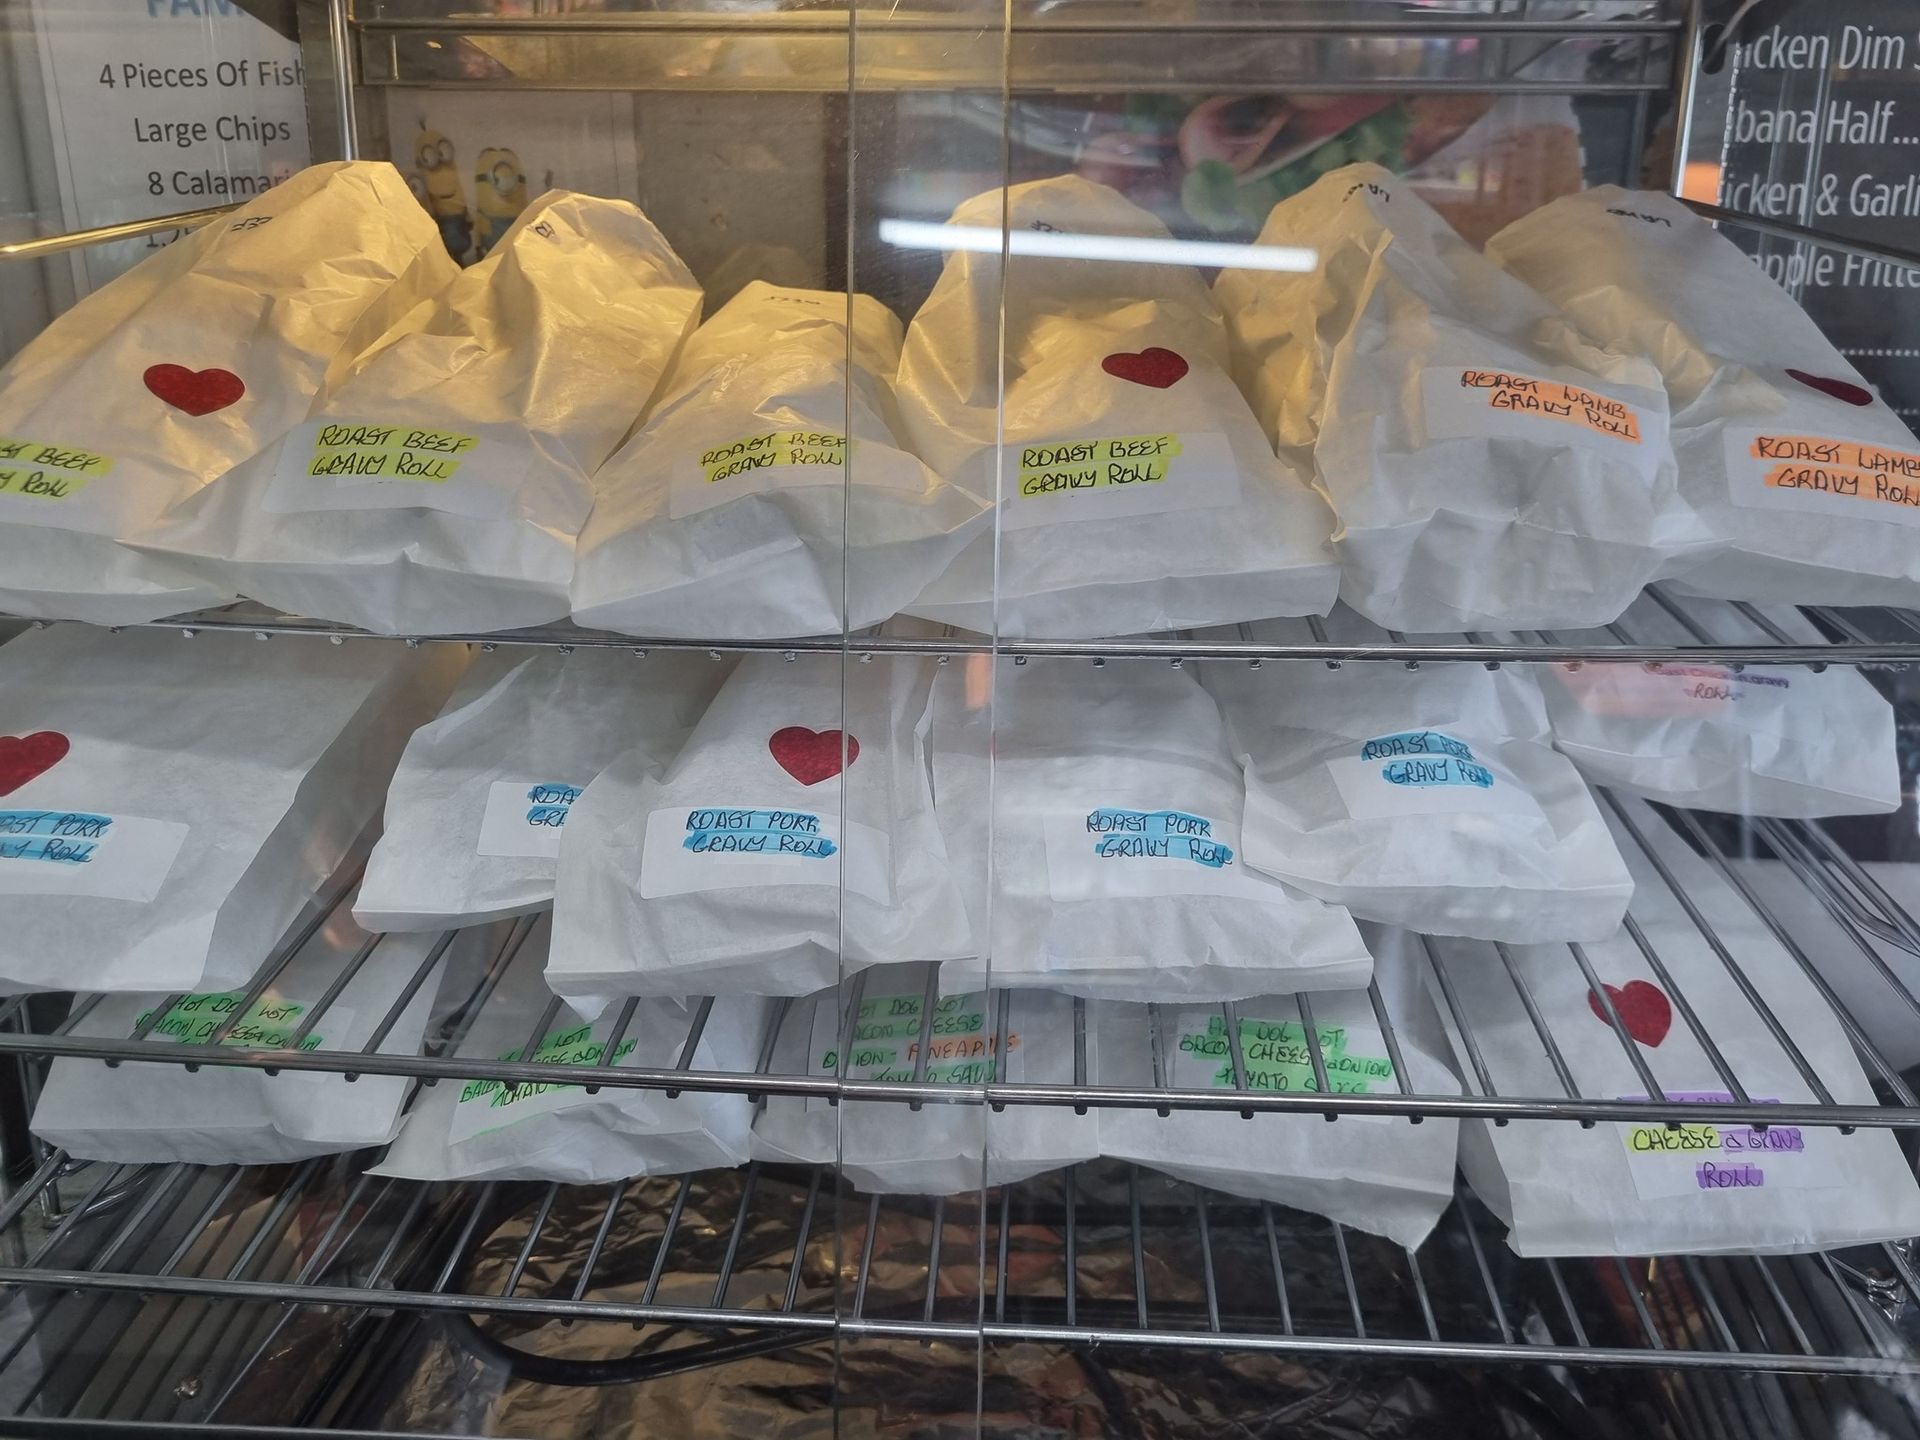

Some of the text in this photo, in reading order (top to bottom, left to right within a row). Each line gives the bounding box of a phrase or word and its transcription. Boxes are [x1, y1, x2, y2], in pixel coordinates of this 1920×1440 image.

[1839, 25, 1906, 70] Dim
[99, 64, 116, 89] 4
[123, 63, 208, 89] Pieces
[216, 60, 249, 87] Of
[134, 115, 291, 148] Large Chips
[149, 171, 165, 196] 8
[1816, 172, 1840, 217] &
[1460, 370, 1627, 420] ROAST LAMB
[1491, 390, 1637, 439] GRAVY ROLL
[319, 424, 472, 453] ROAST BEEF
[701, 432, 848, 467] ROAST BEEF
[1022, 437, 1168, 468] ROAST BEEF
[1758, 436, 1841, 464] ROAST
[32, 447, 101, 471] BEEF
[312, 451, 449, 479] GRAVY ROLL
[711, 448, 842, 482] GRAVY ROLL
[1023, 463, 1162, 495] GRAVY ROLL
[1777, 468, 1859, 495] GRAVY
[1364, 731, 1431, 761] ROAST
[1389, 758, 1449, 784] GRAVY
[51, 813, 113, 838] PORK
[685, 810, 820, 832] ROAST PORK
[1086, 810, 1212, 837] ROAST PORK
[39, 838, 94, 862] ROLL
[692, 833, 834, 857] GRAVY ROLL
[1101, 837, 1234, 865] GRAVY ROLL
[906, 1013, 984, 1036] CEESE
[1248, 1043, 1312, 1067] CHEES
[1633, 1126, 1722, 1151] CHEESE
[1703, 1161, 1762, 1189] ROLL
